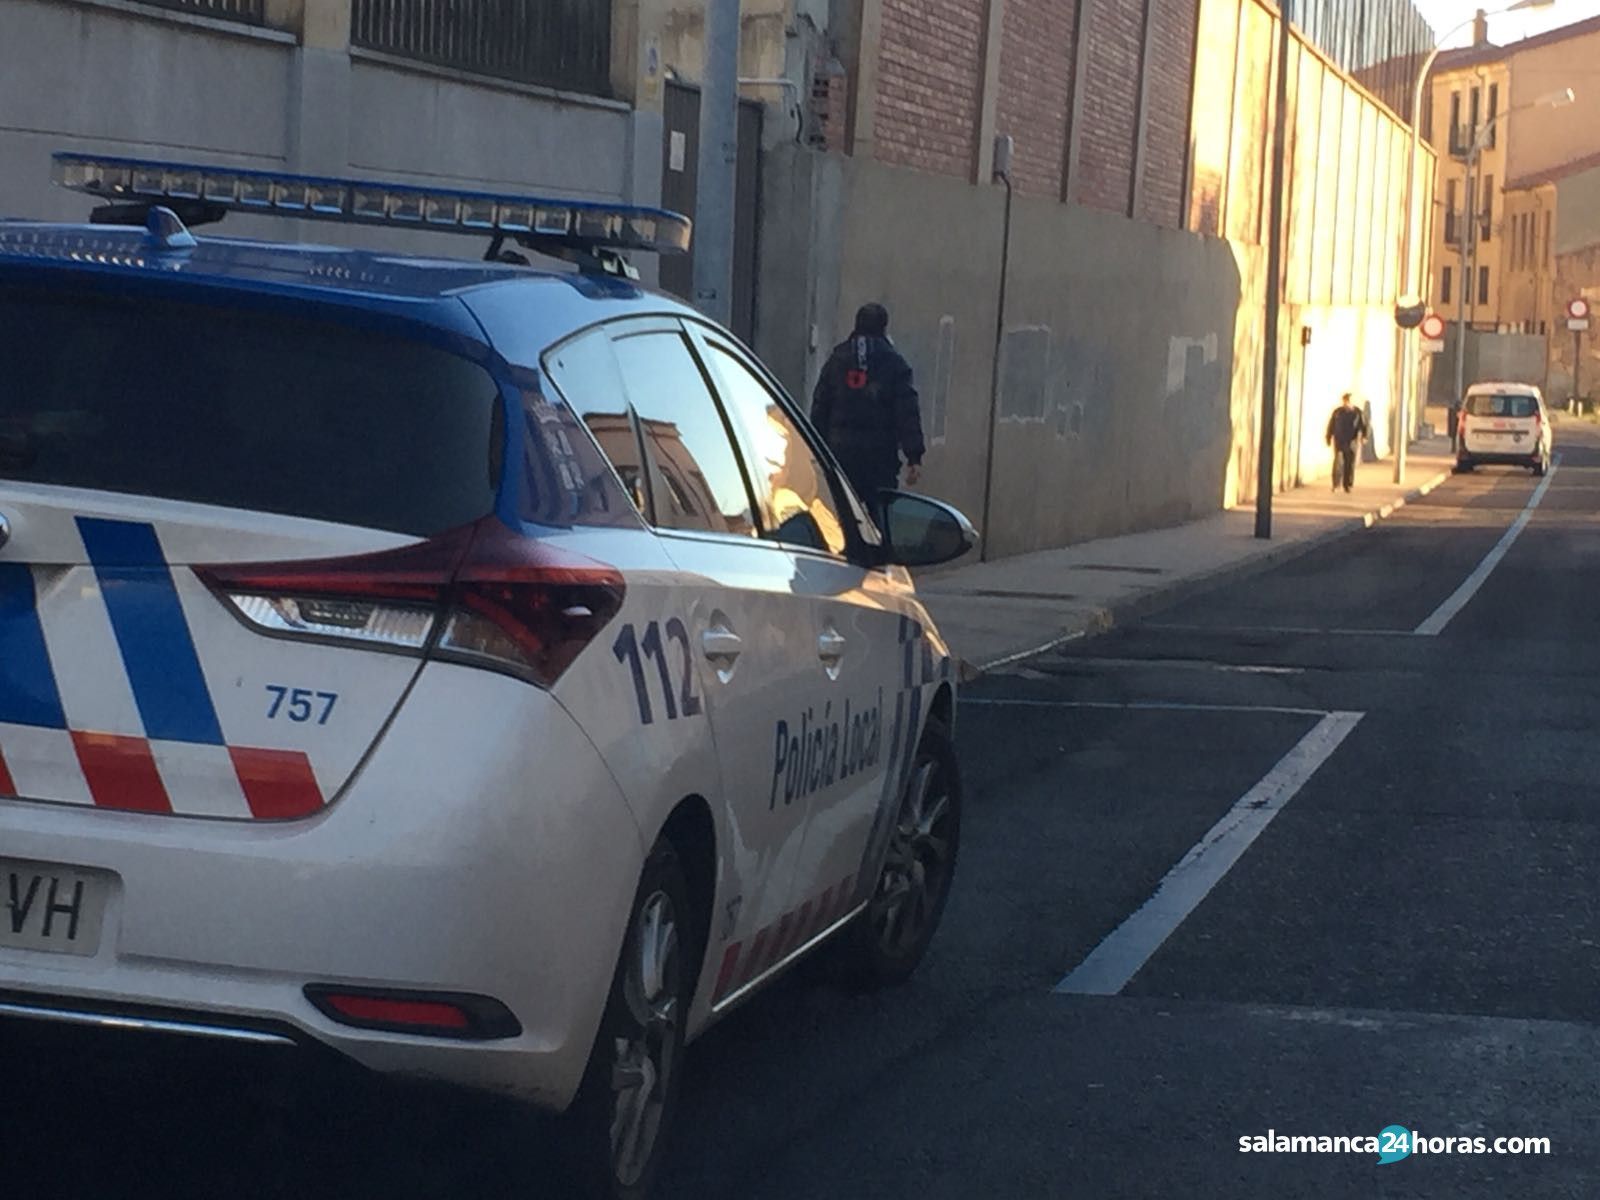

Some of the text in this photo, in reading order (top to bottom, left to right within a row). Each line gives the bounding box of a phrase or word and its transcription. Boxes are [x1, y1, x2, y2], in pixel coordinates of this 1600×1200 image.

[265, 684, 338, 725] 757
[613, 616, 703, 725] 112
[769, 685, 882, 811] Policía Local
